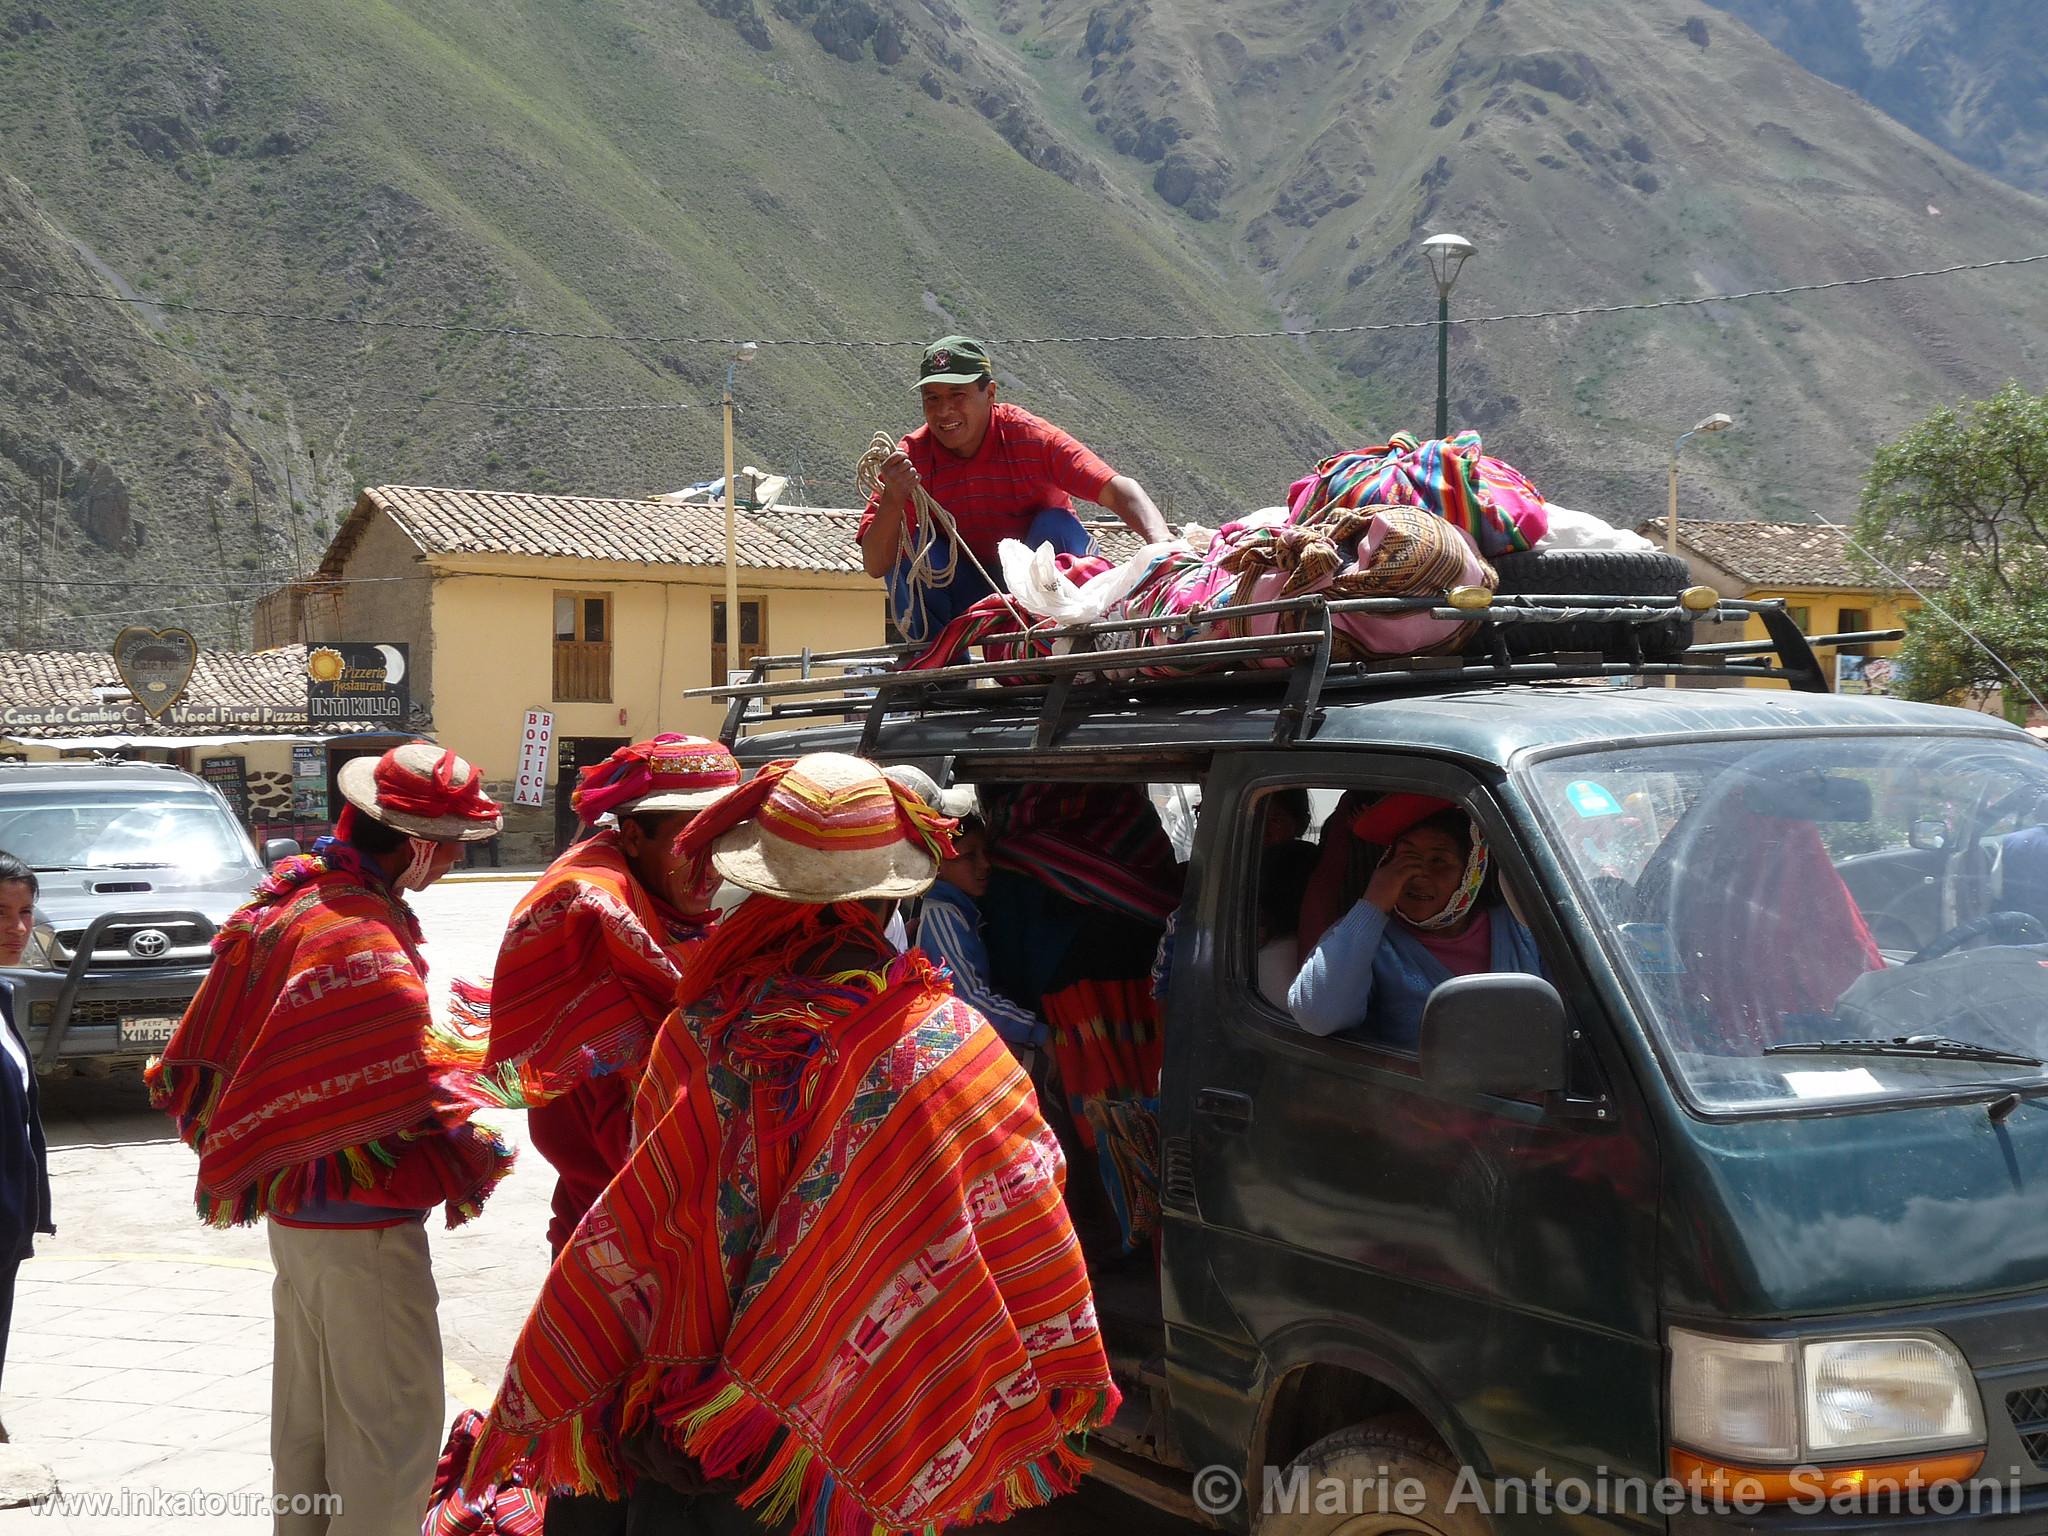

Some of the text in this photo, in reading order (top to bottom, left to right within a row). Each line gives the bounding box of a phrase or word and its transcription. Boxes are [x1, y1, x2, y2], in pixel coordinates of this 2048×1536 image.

[344, 666, 388, 679] Pizzeria
[332, 680, 387, 697] Restaurant
[3, 708, 42, 725] Casa
[44, 708, 65, 724] de
[66, 706, 121, 723] Cambio
[170, 707, 309, 723] Wood Fired Pizzas
[311, 696, 401, 717] INTI KILLA
[517, 713, 537, 802] BOTICA
[531, 715, 550, 803] BOTICA
